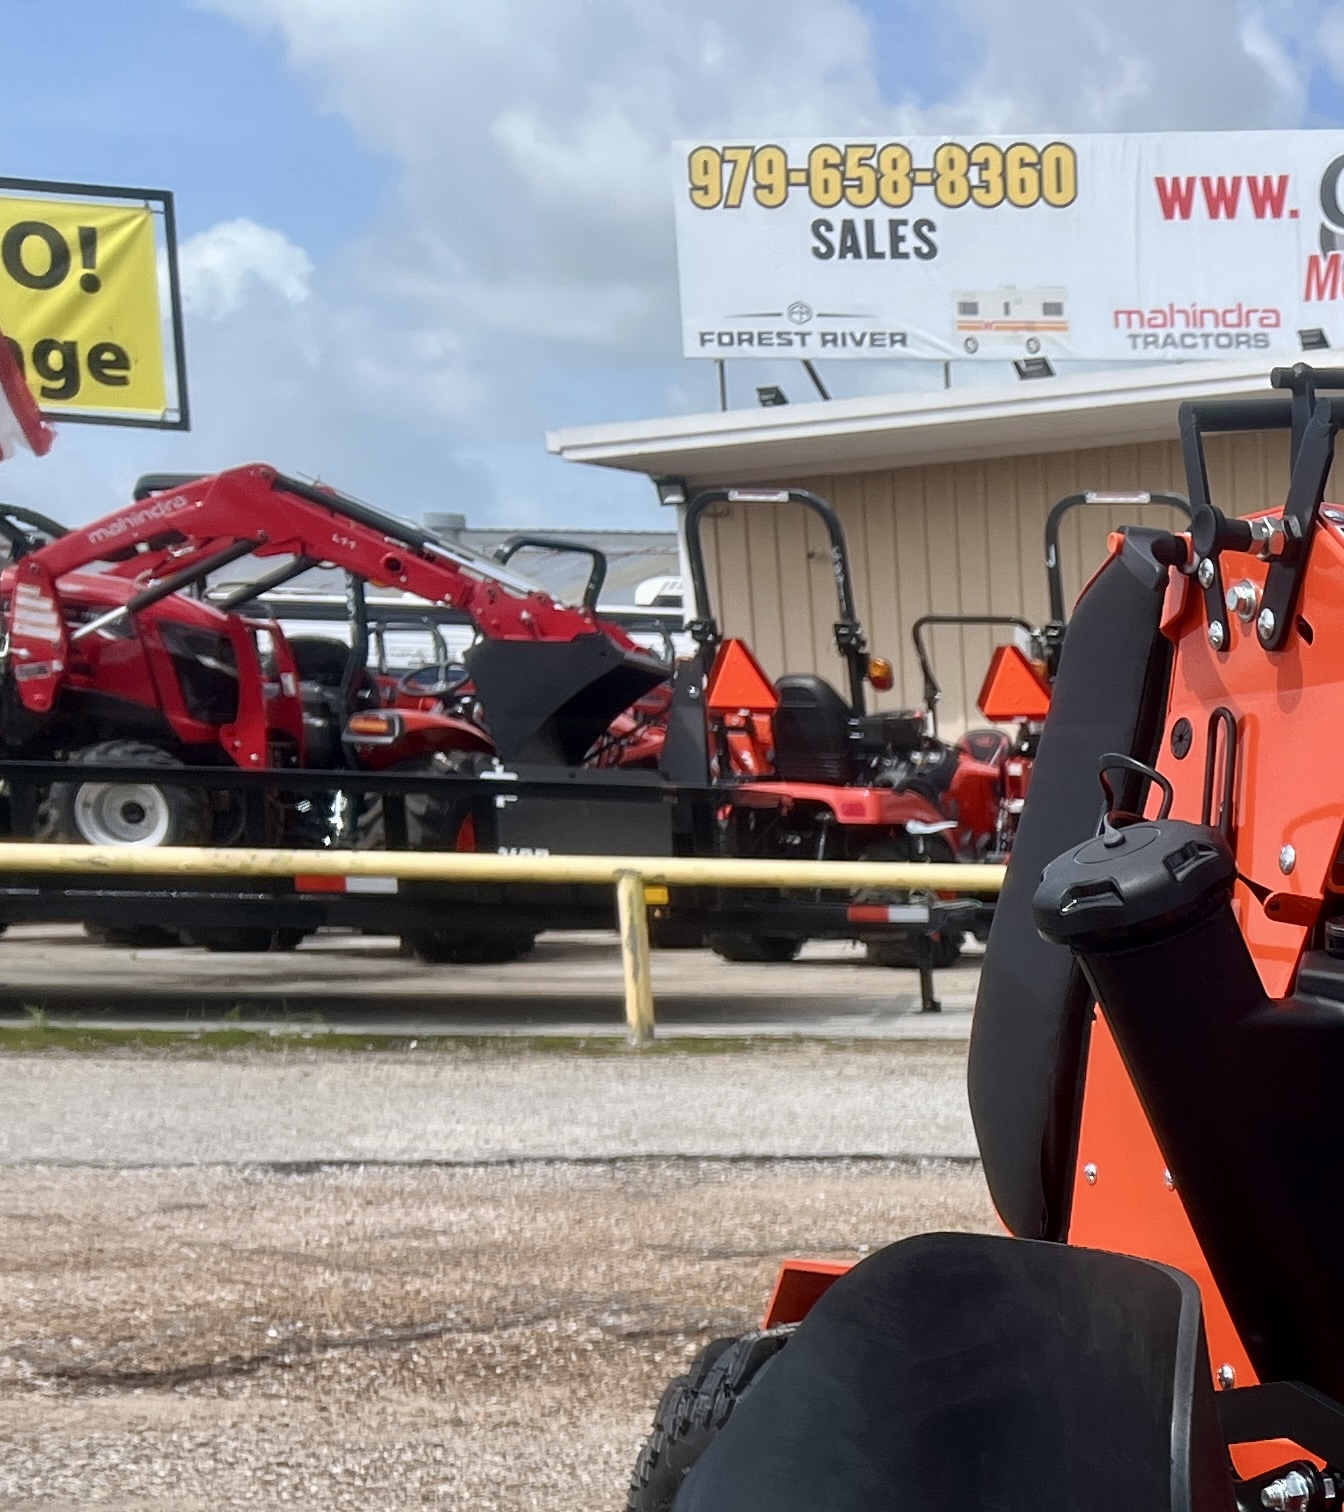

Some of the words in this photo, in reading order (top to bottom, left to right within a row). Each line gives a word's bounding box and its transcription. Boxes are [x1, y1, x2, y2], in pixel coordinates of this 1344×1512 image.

[688, 142, 1078, 209] 979-658-8360
[811, 218, 938, 260] SALES
[1114, 303, 1281, 330] mahindra
[699, 331, 814, 348] FOREST
[821, 331, 907, 348] RIVER
[1127, 332, 1270, 350] TRACTORS
[4, 336, 131, 400] ge
[87, 496, 189, 544] mahindra
